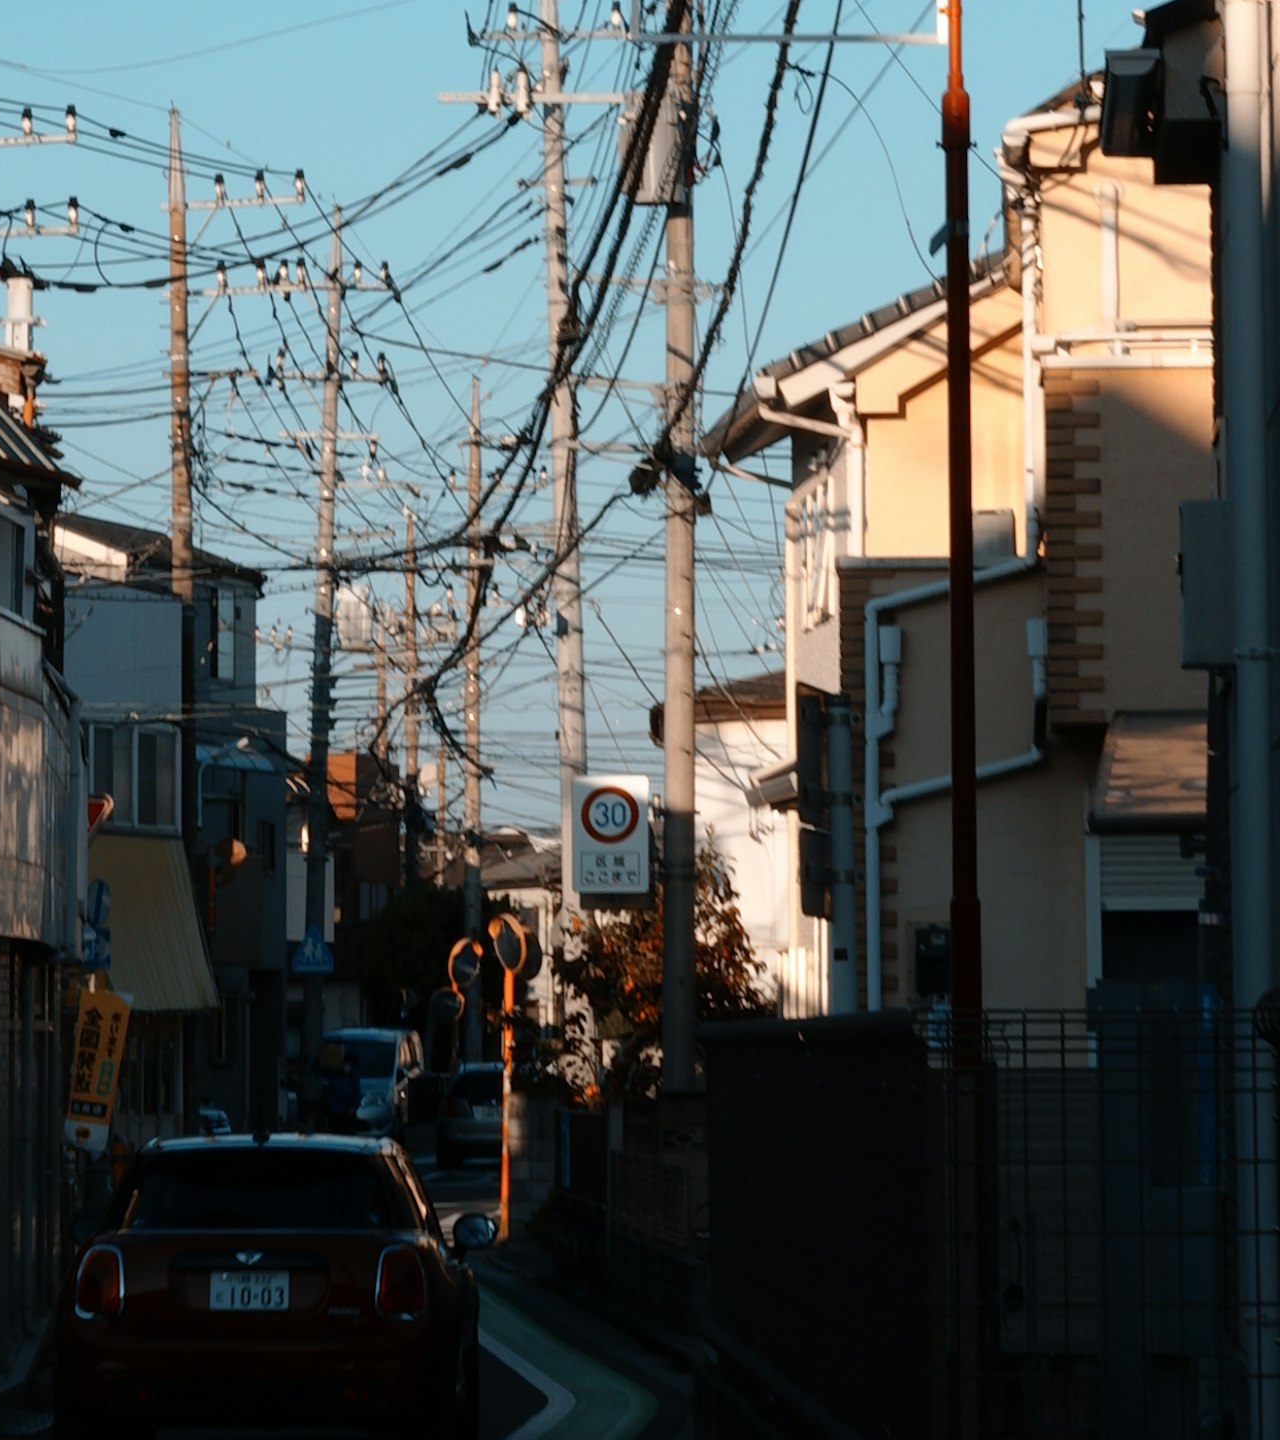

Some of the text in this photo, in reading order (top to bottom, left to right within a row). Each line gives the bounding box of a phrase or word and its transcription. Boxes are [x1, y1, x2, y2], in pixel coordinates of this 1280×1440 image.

[595, 802, 626, 827] 30
[585, 871, 637, 883] ここまで
